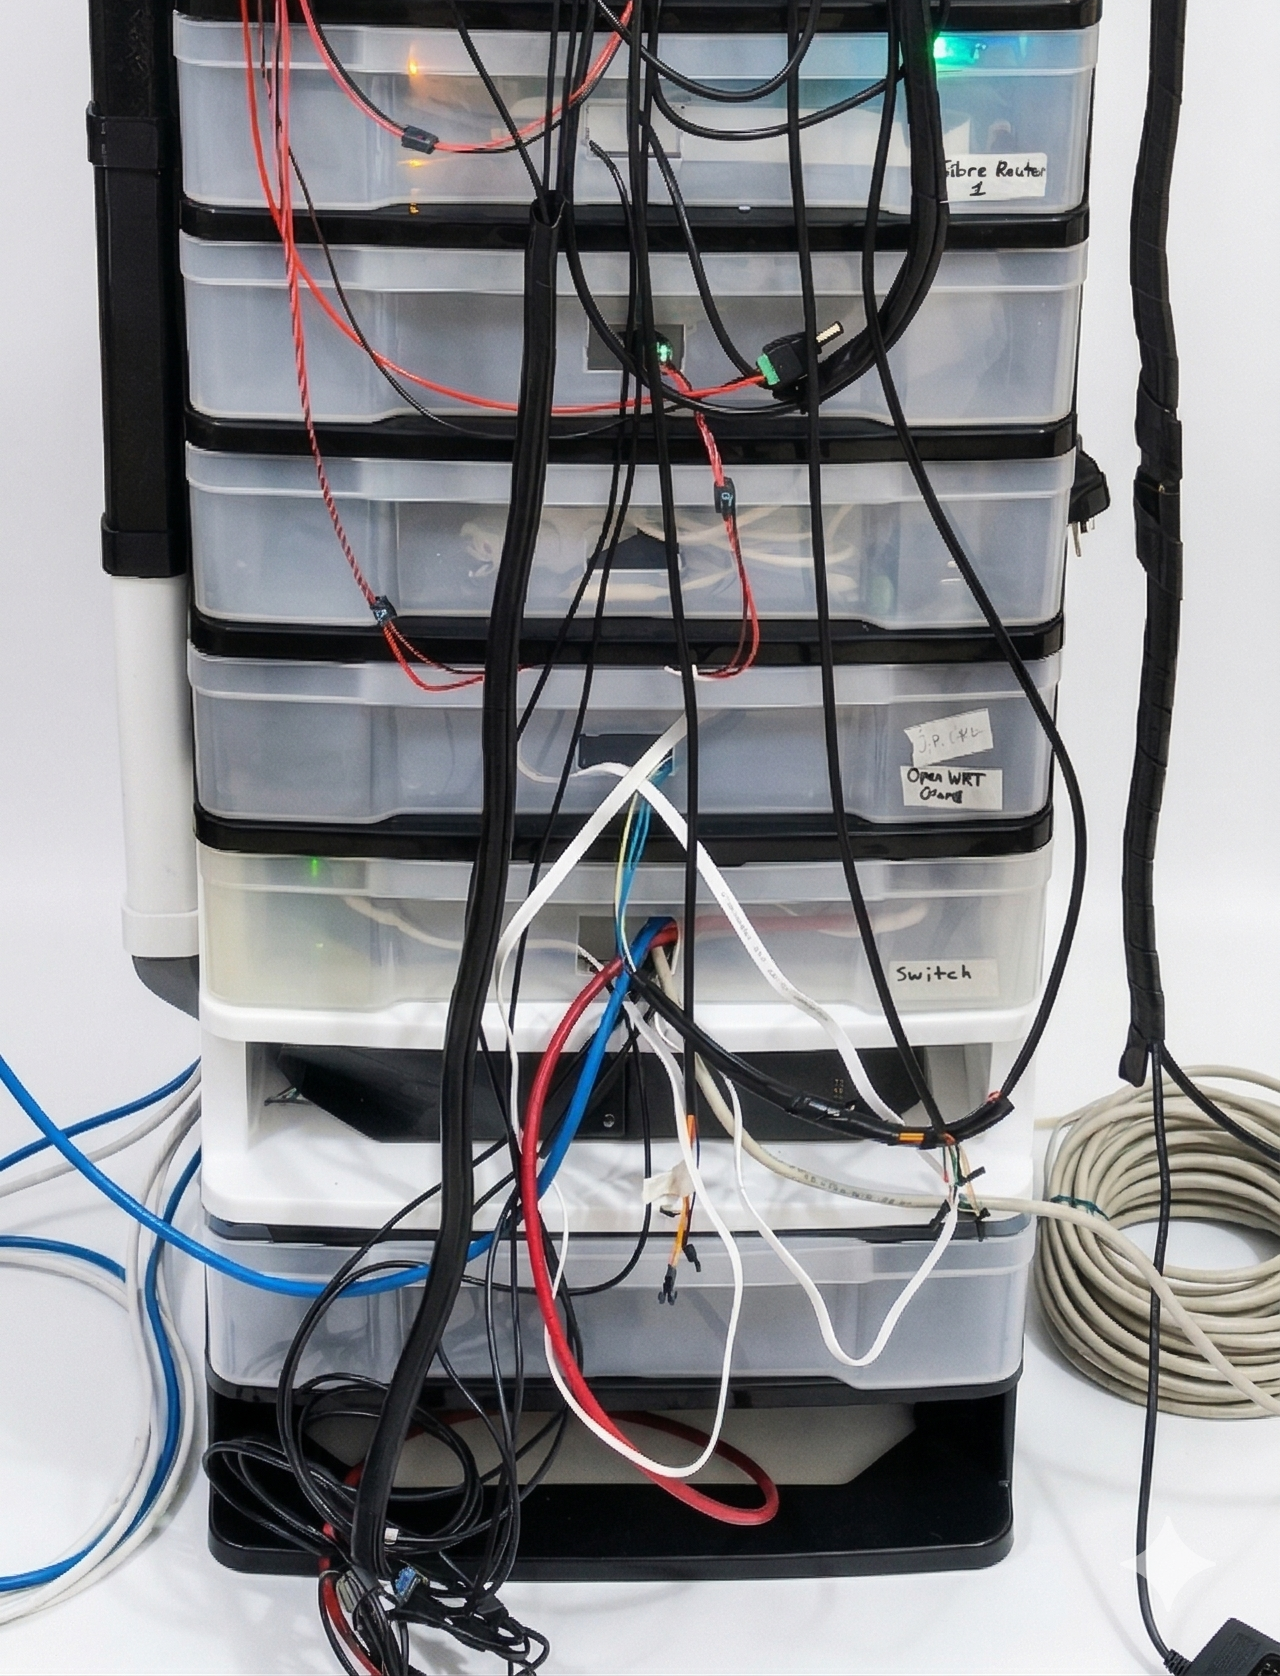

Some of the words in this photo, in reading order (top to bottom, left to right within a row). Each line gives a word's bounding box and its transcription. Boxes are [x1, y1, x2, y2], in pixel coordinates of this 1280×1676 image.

[969, 180, 986, 196] 1
[948, 769, 986, 787] WRT
[896, 964, 972, 982] Switch
